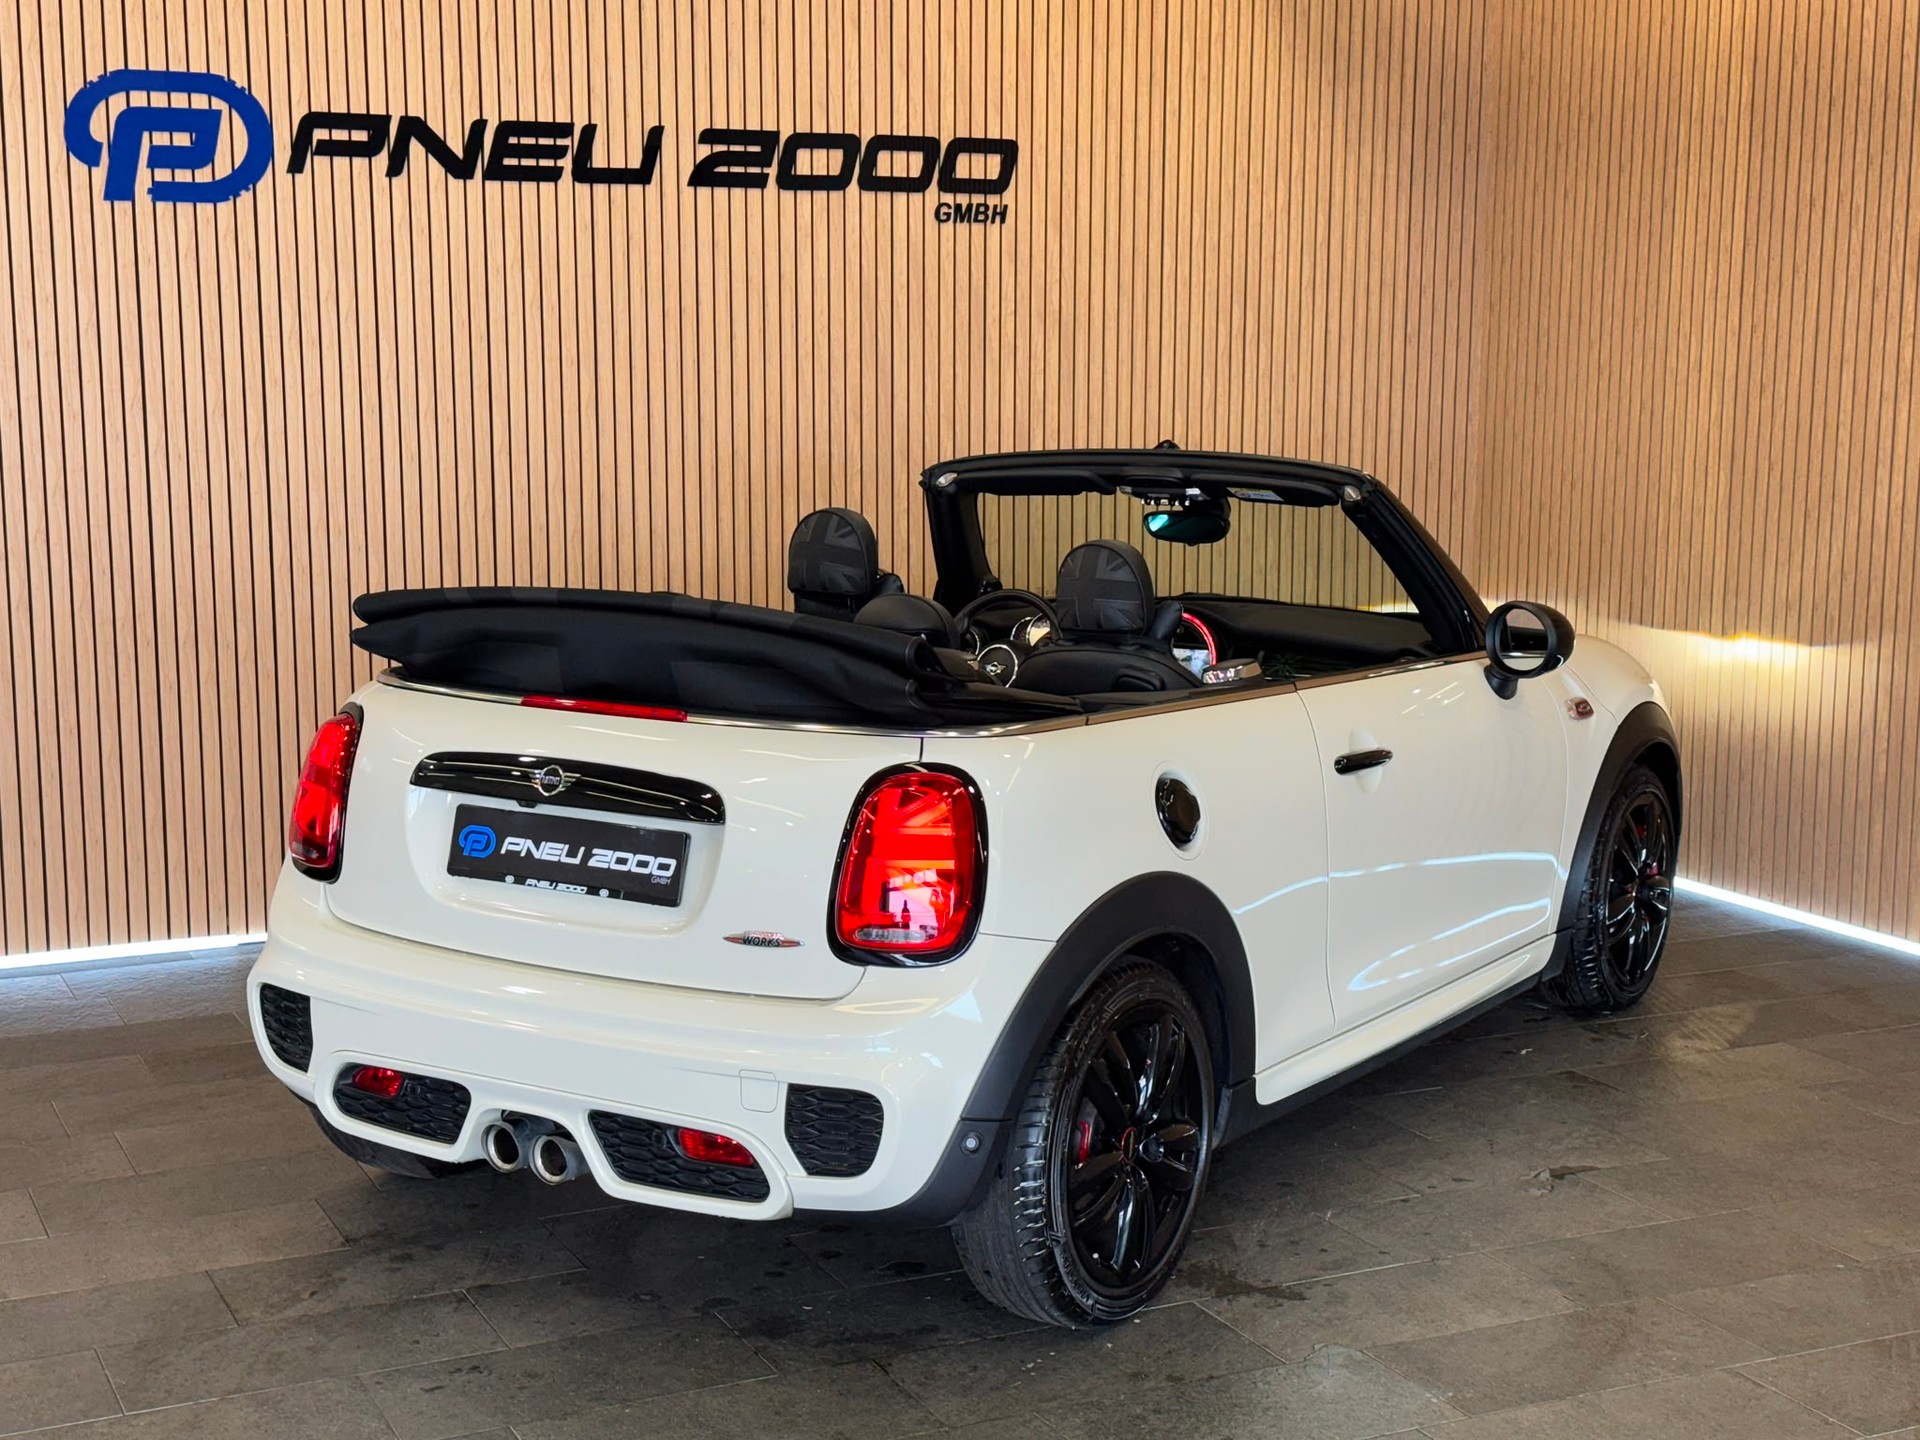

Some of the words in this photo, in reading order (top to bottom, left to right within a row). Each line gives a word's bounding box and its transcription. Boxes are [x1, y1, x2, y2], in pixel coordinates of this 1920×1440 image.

[287, 112, 664, 186] PNEU
[687, 128, 1018, 195] 2000
[934, 202, 1008, 225] GMBH
[500, 836, 586, 865] PNEU
[587, 848, 677, 877] 2000
[525, 878, 556, 889] PNEU
[556, 883, 588, 894] 2000
[743, 936, 781, 947] WORKS
